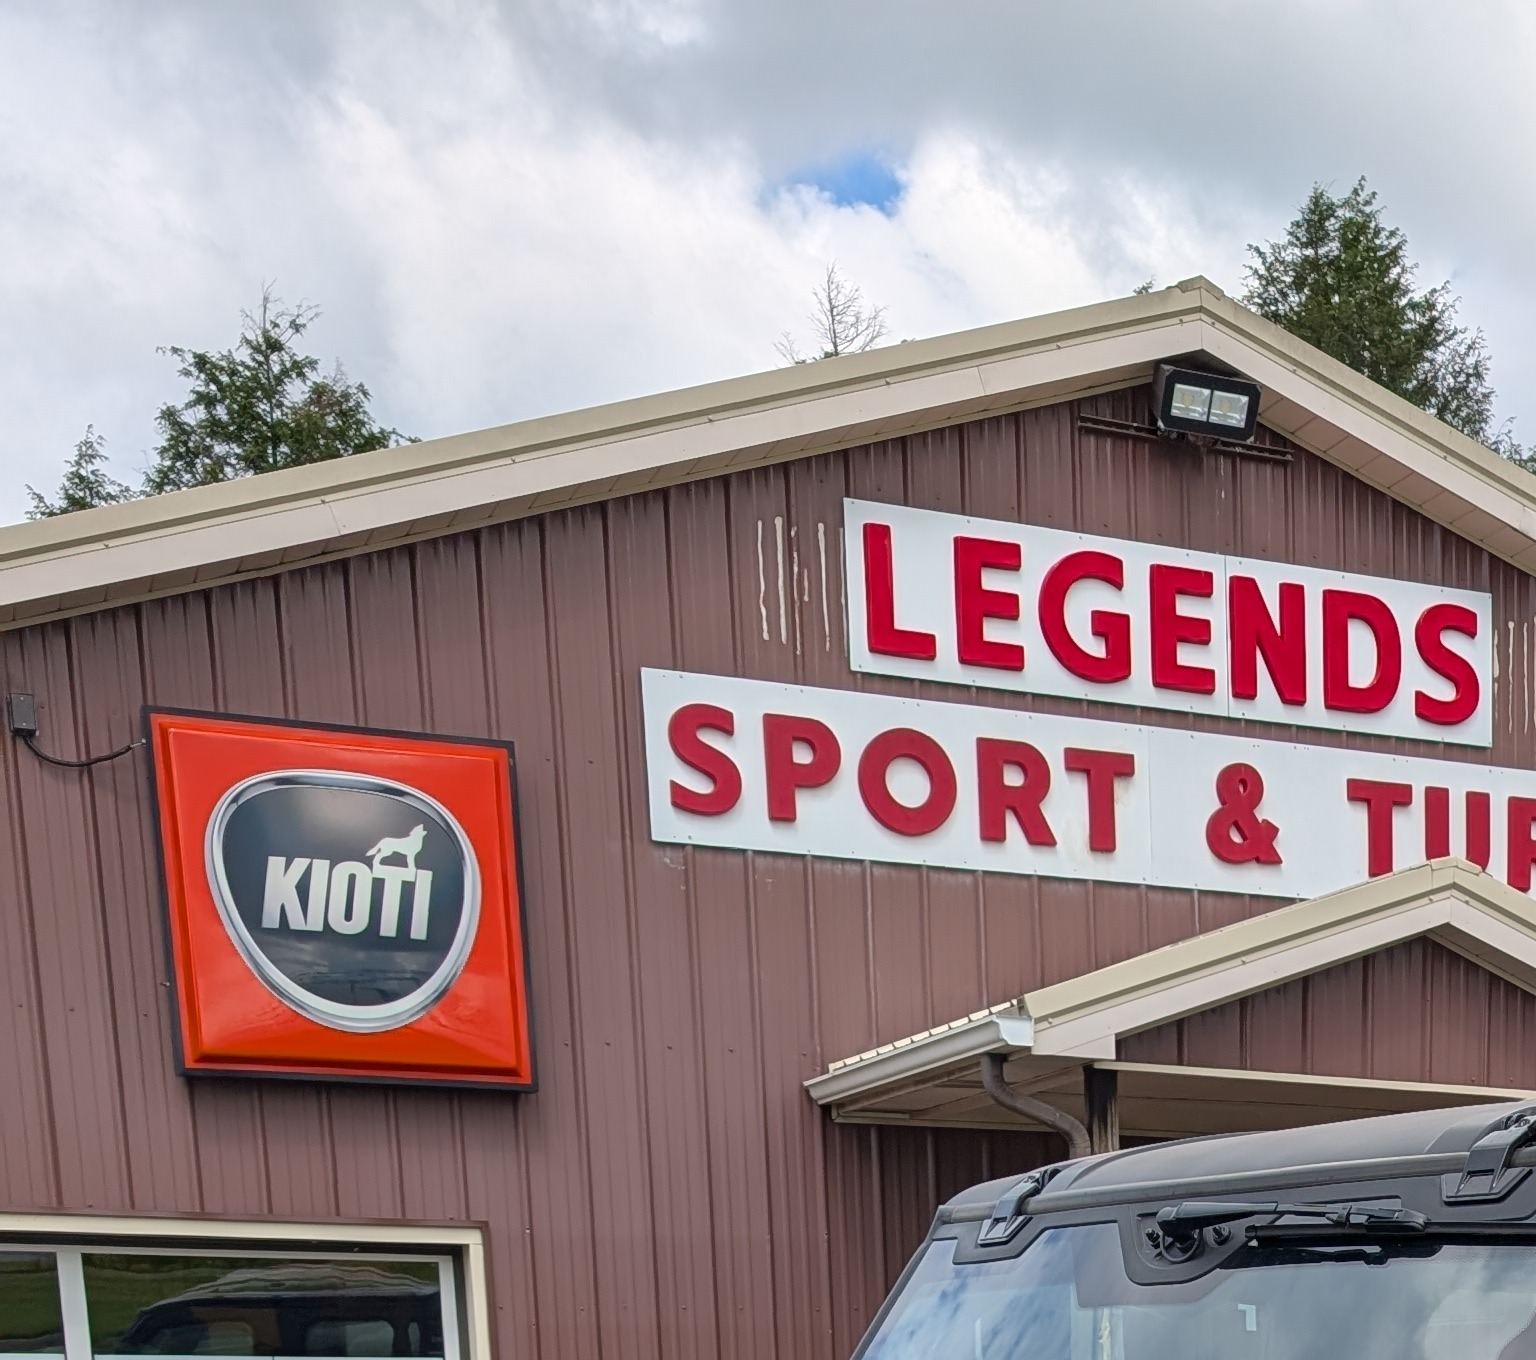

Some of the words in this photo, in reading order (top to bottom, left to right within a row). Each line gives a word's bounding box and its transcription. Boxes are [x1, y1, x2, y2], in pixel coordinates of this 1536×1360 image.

[863, 522, 1480, 725] LEGENDS
[668, 703, 1135, 853] SPORT
[1206, 762, 1283, 864] &
[261, 855, 433, 940] KIOTI
